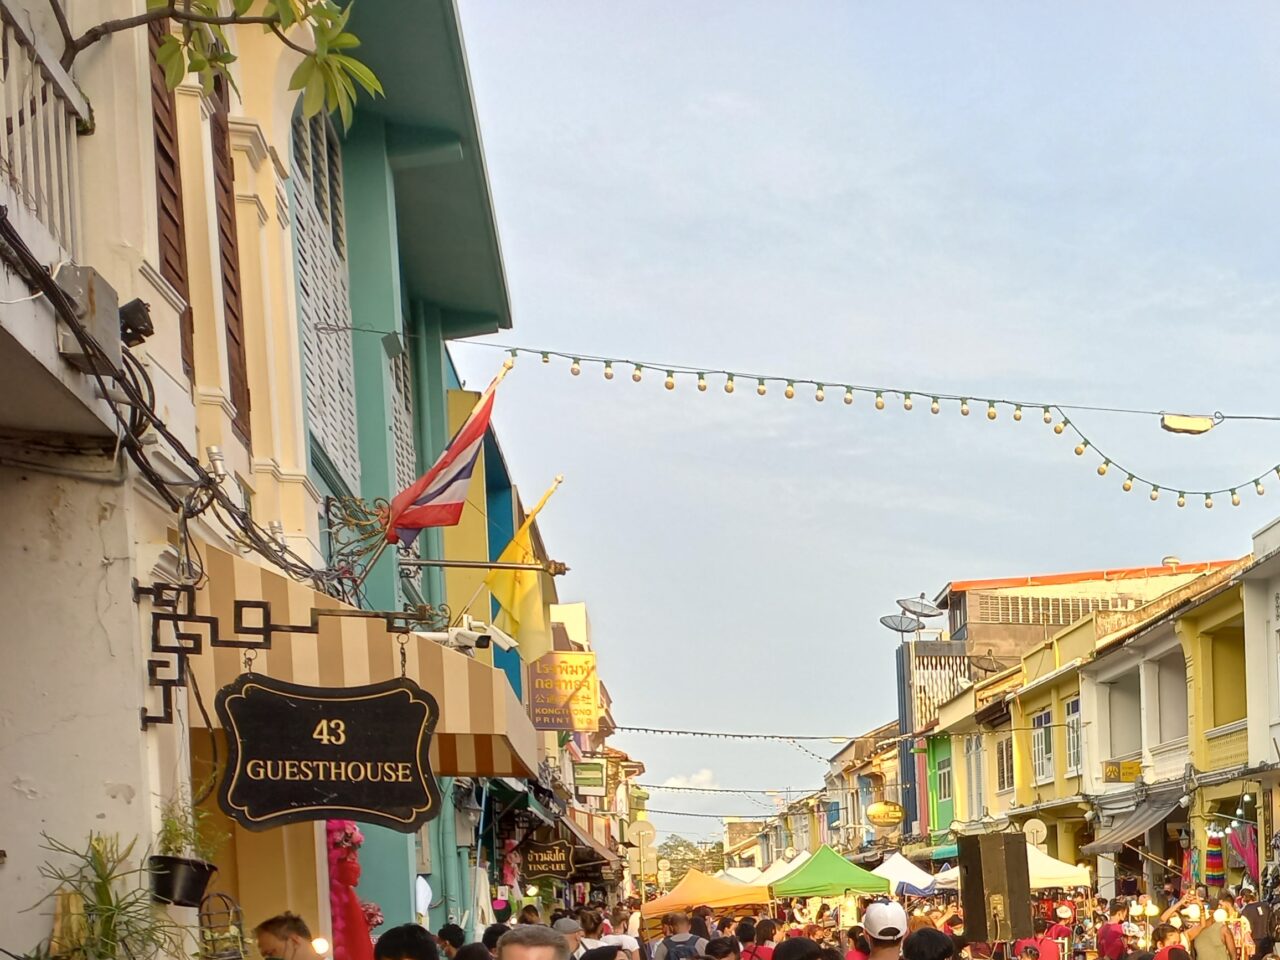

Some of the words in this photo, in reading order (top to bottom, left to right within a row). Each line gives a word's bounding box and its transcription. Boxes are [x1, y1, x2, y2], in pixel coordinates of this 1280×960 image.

[535, 717, 593, 725] PRINTNG
[312, 719, 346, 745] 43
[246, 759, 412, 782] GUESTHOUSE
[528, 863, 566, 871] TING-LEE
